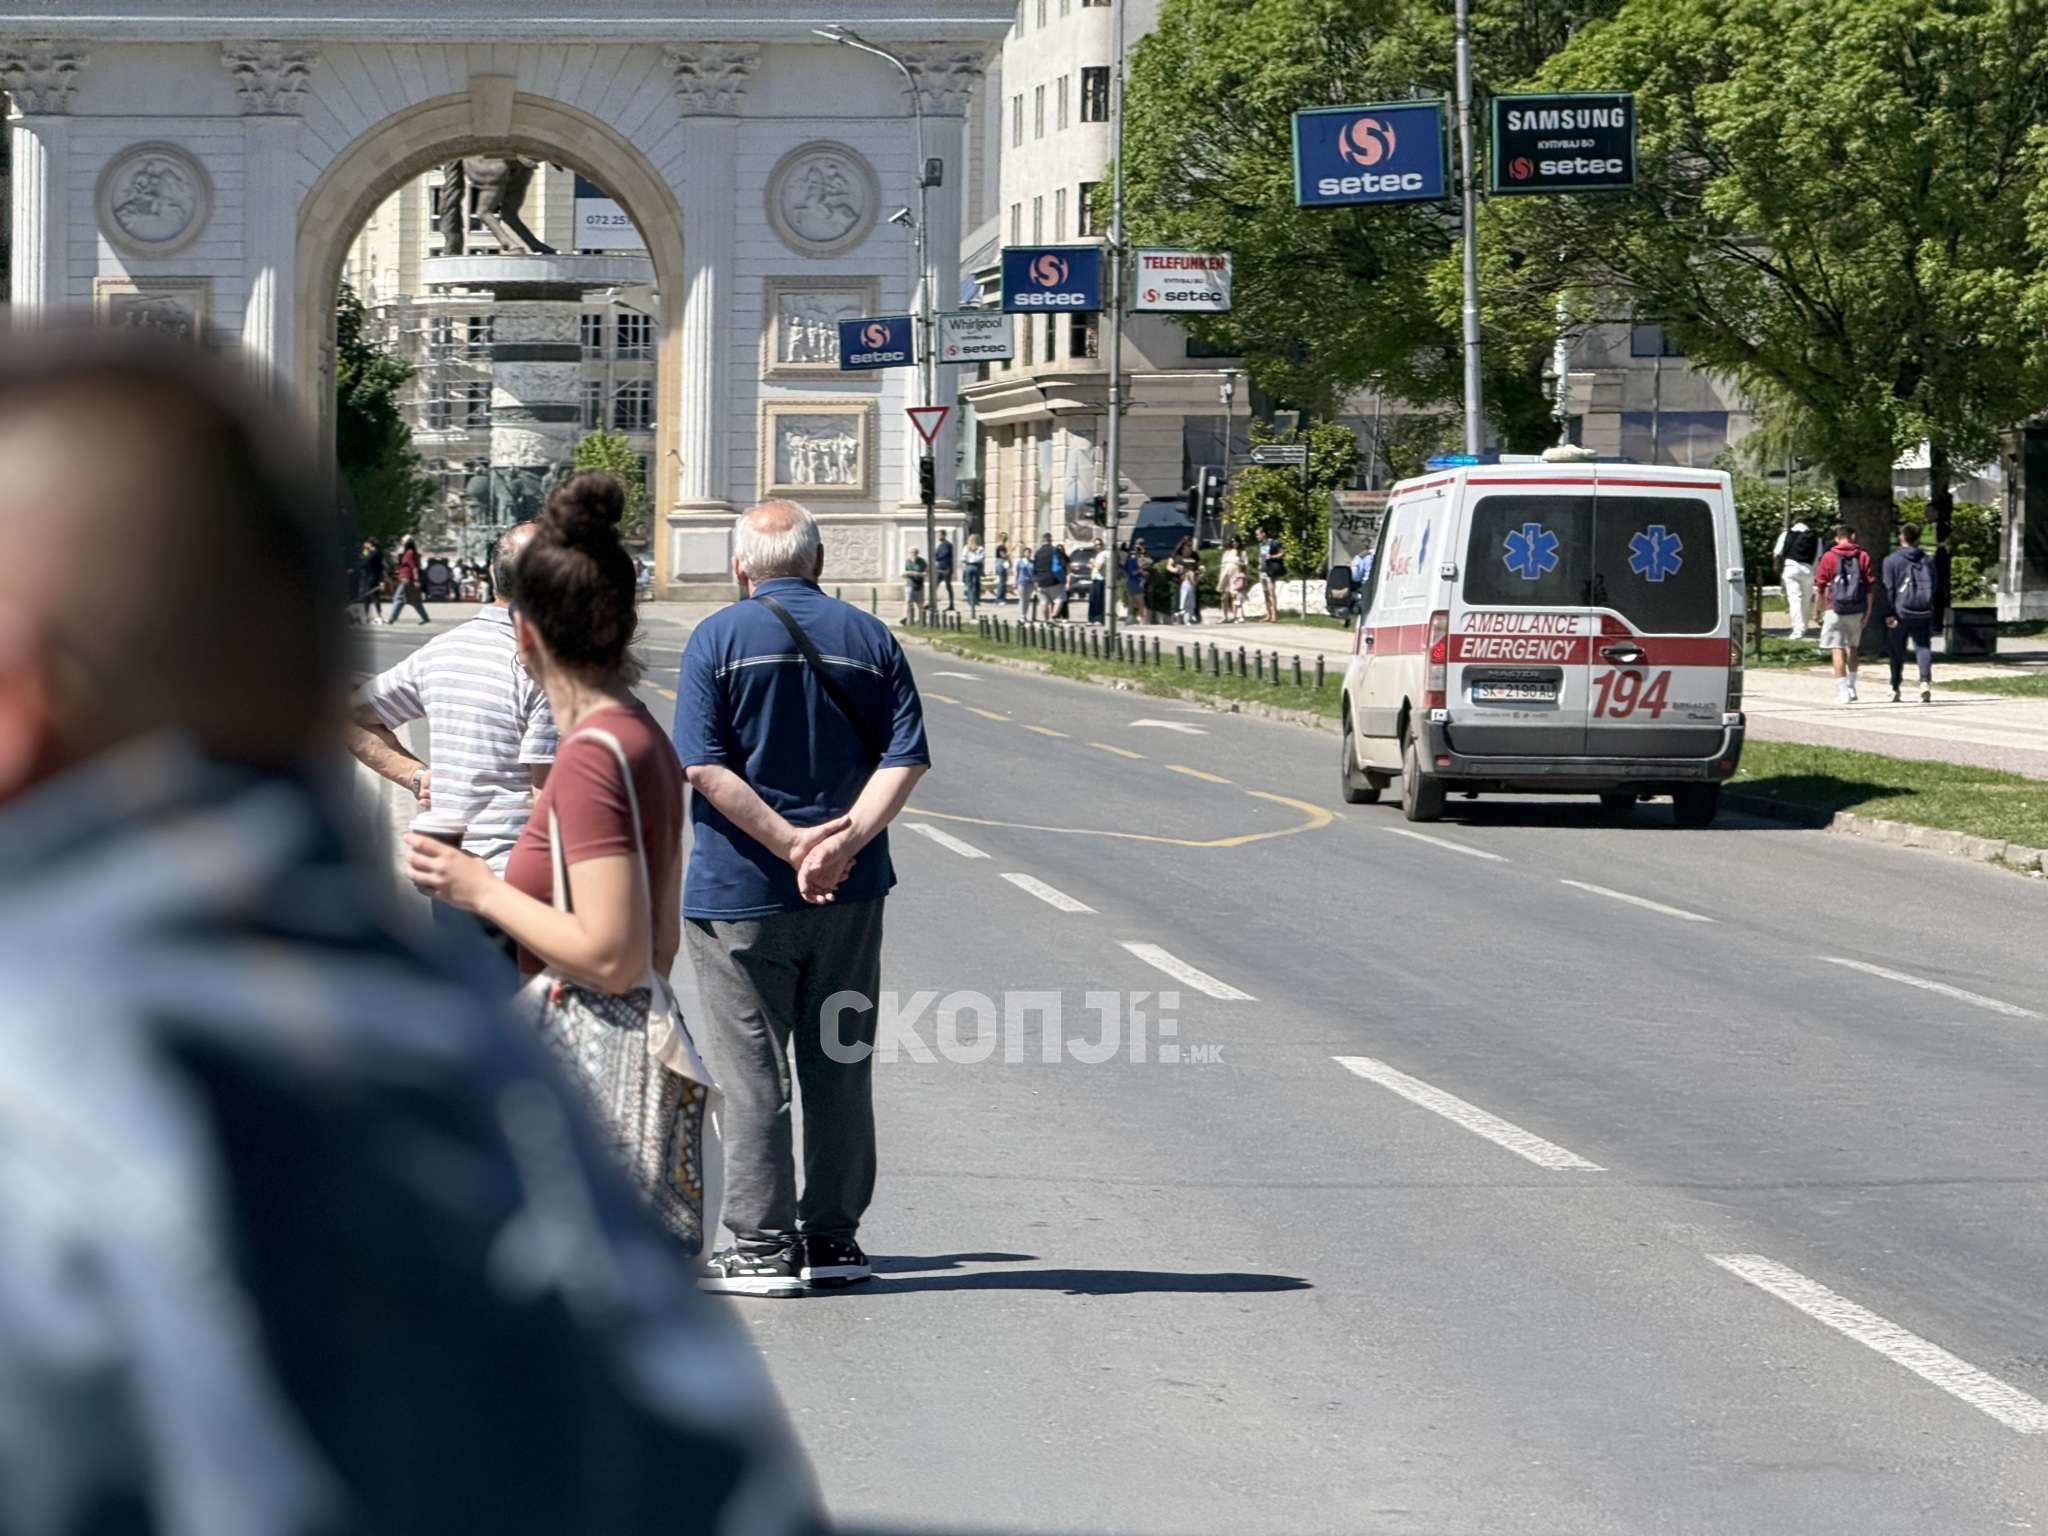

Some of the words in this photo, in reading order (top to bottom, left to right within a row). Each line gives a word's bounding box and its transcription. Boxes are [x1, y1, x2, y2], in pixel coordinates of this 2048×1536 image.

[1507, 108, 1625, 131] SAMSUNG
[1539, 157, 1623, 175] setec
[1318, 172, 1422, 196] setec
[586, 215, 609, 225] 072
[1143, 256, 1225, 270] TELEFUNKEN
[1014, 291, 1085, 306] setec
[1165, 290, 1222, 302] setec
[948, 317, 1003, 333] Whirlpool
[962, 344, 1007, 354] setec
[850, 351, 904, 364] setec
[1464, 613, 1578, 634] AMBULANCE
[1459, 638, 1577, 660] EMERGENCY
[1592, 669, 1672, 719] 194
